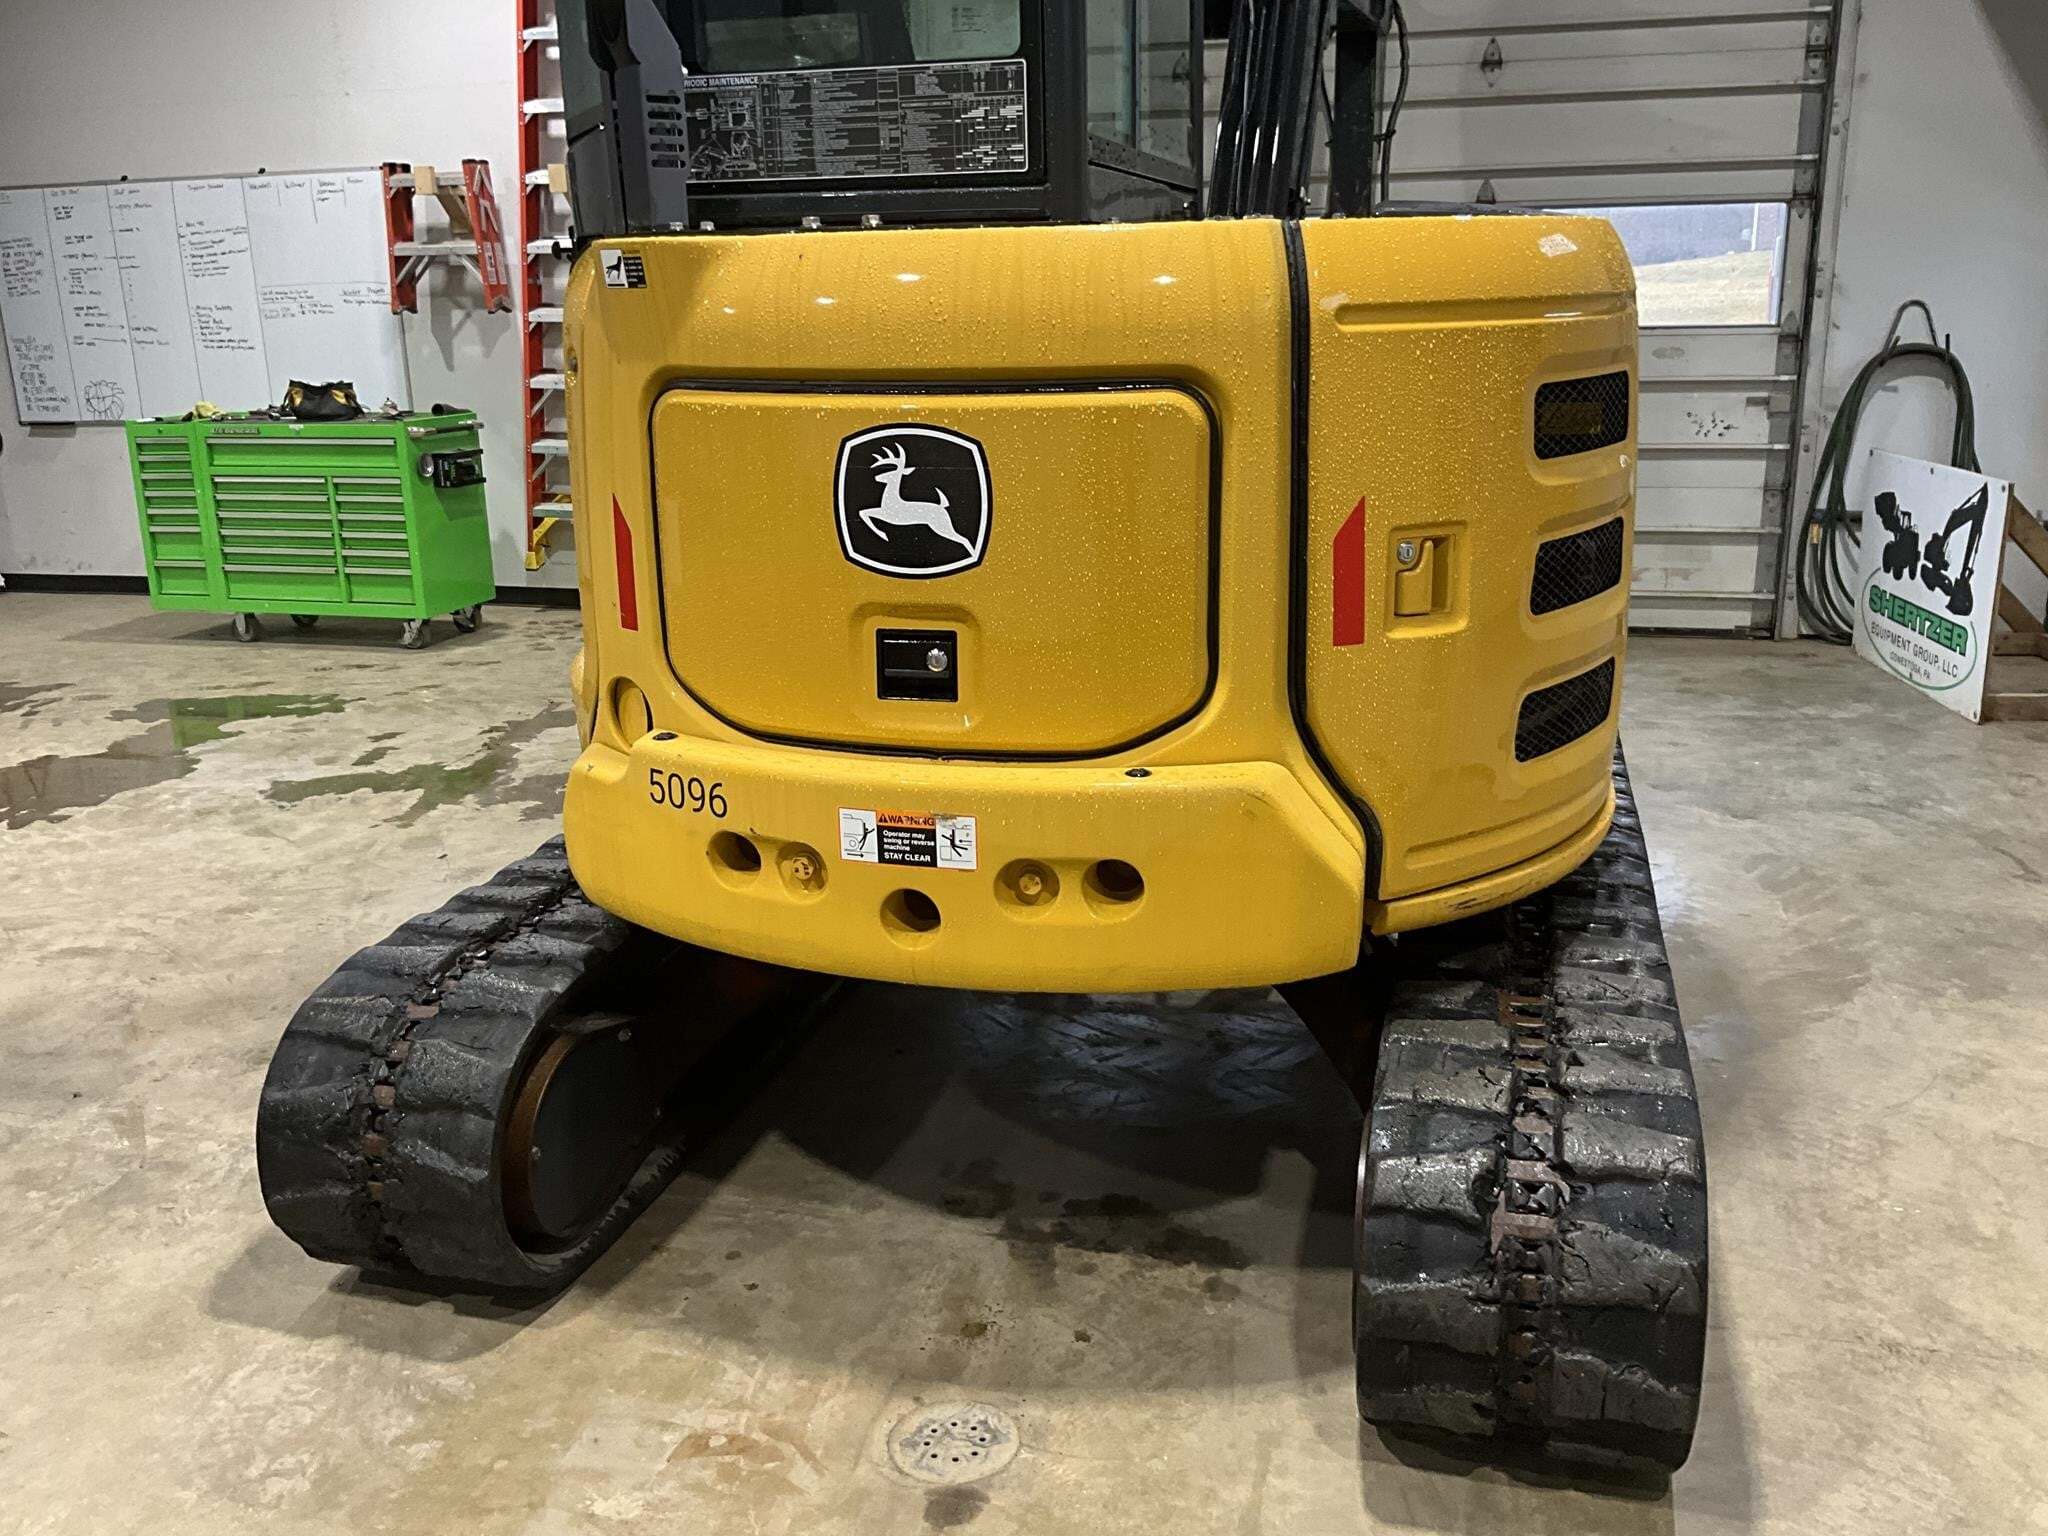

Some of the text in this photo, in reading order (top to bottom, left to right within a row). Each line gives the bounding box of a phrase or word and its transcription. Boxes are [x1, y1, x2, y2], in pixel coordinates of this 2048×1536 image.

[709, 76, 759, 87] MAINTENANCE
[1869, 584, 1969, 657] SHERTZER
[1871, 621, 1959, 679] EQUIPMENT GROUP, LLC
[650, 767, 728, 819] 5096
[883, 829, 926, 840] Operator may
[884, 852, 931, 863] STAY CLEAR
